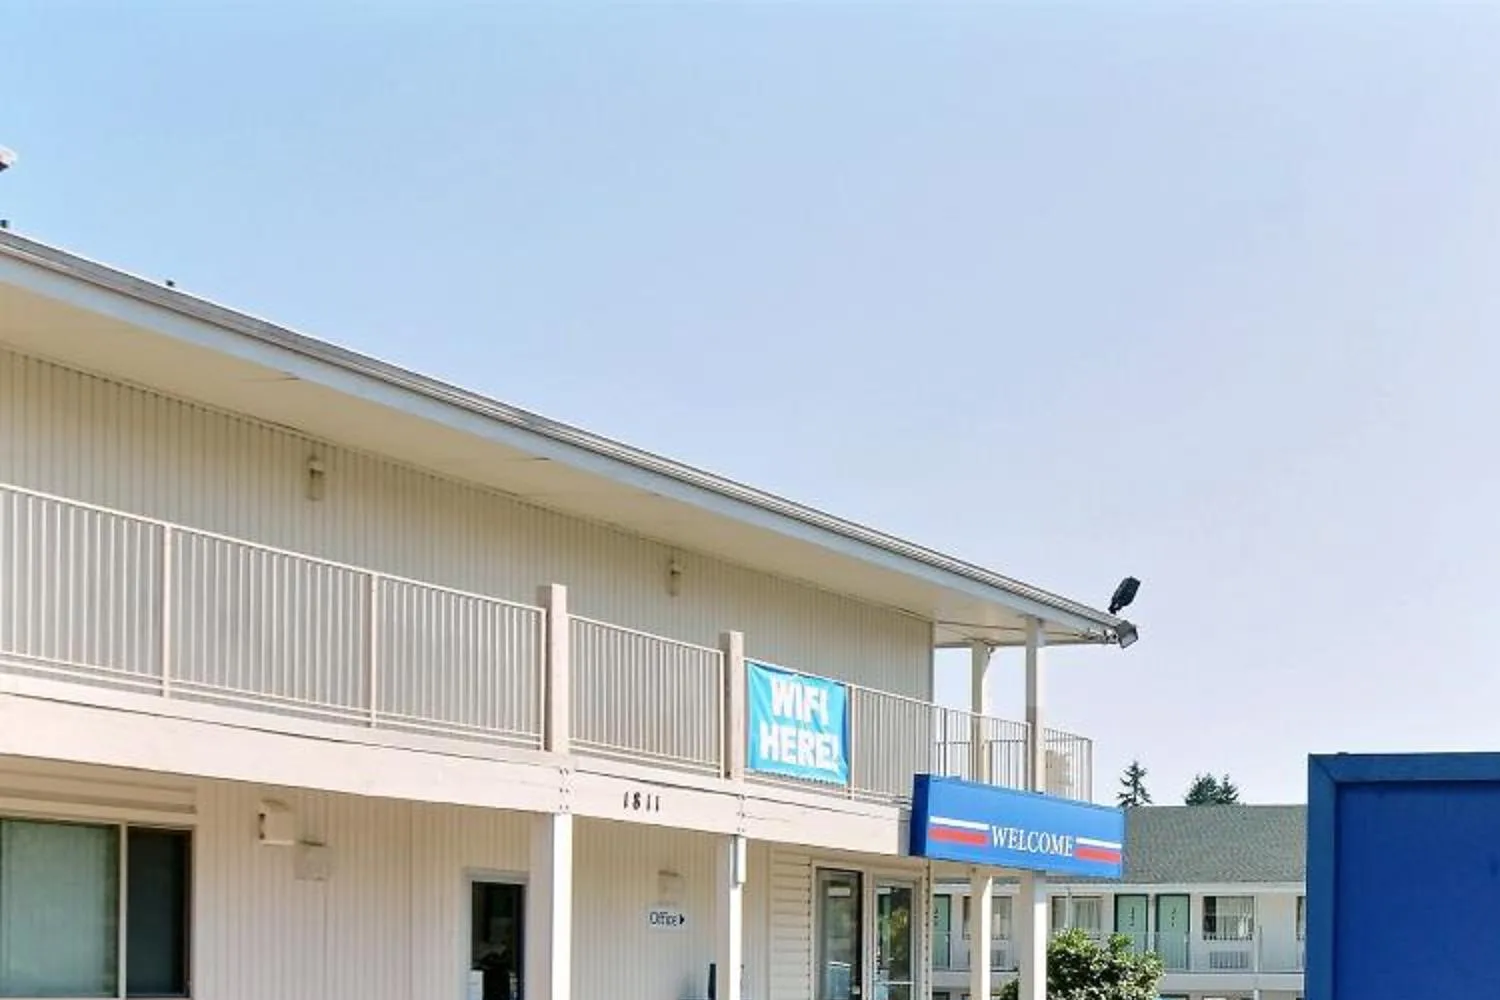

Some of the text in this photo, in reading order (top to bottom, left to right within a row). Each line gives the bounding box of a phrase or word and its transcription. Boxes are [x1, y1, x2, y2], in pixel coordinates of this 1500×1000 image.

[771, 675, 829, 725] WIFI
[623, 791, 660, 812] 1811
[991, 825, 1073, 857] WELCOME
[649, 911, 677, 927] Office
